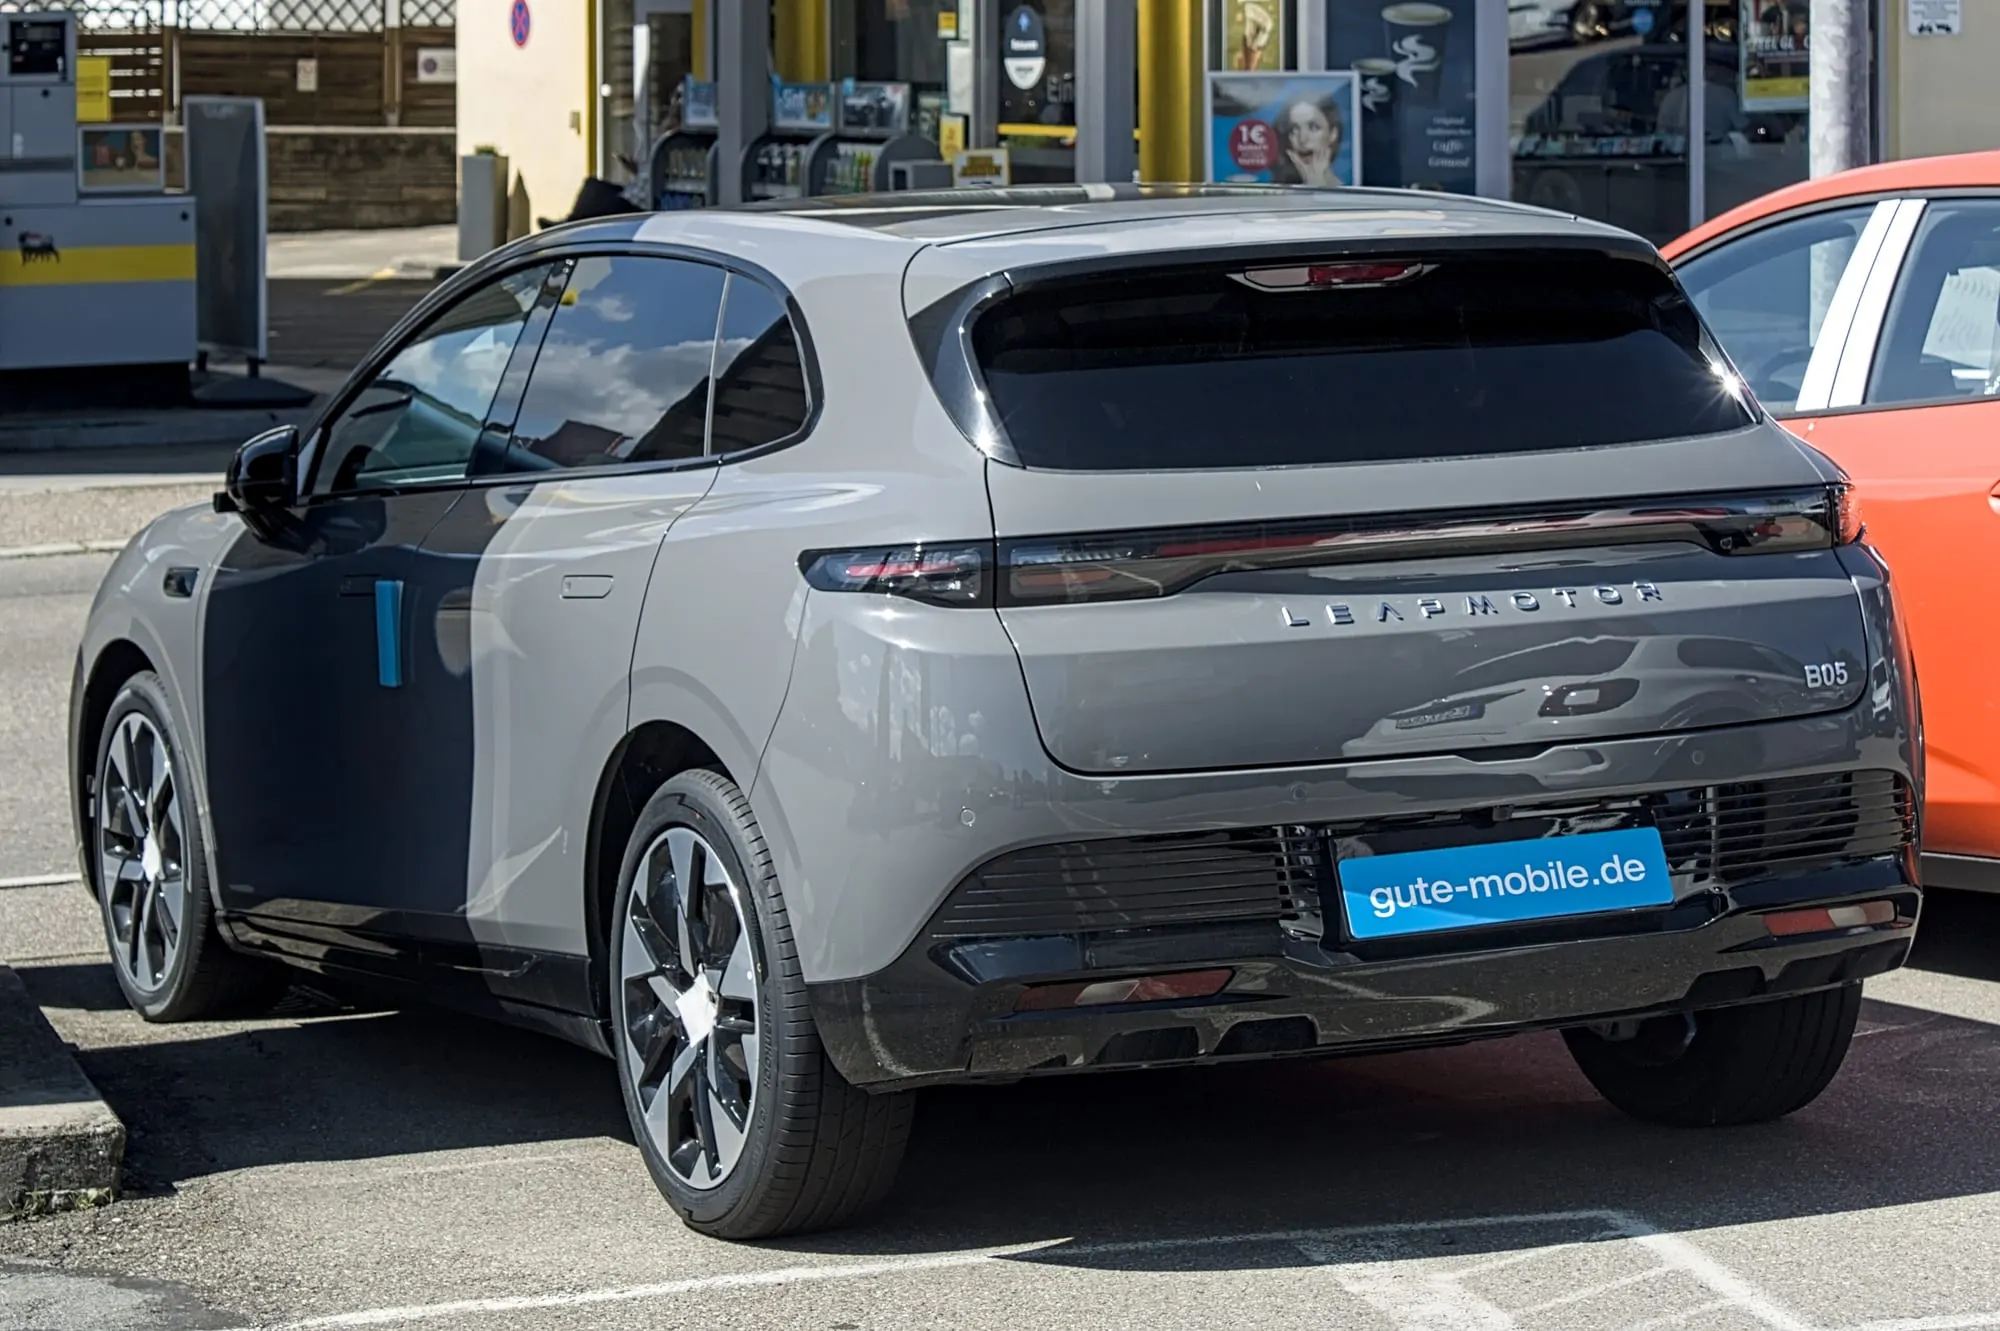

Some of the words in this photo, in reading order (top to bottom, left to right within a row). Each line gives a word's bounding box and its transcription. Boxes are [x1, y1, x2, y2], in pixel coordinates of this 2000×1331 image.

[1238, 124, 1267, 145] 1€
[1281, 579, 1663, 627] LEAPMOTOR
[1804, 662, 1848, 689] B05
[1369, 854, 1647, 918] gute-mobile.de
